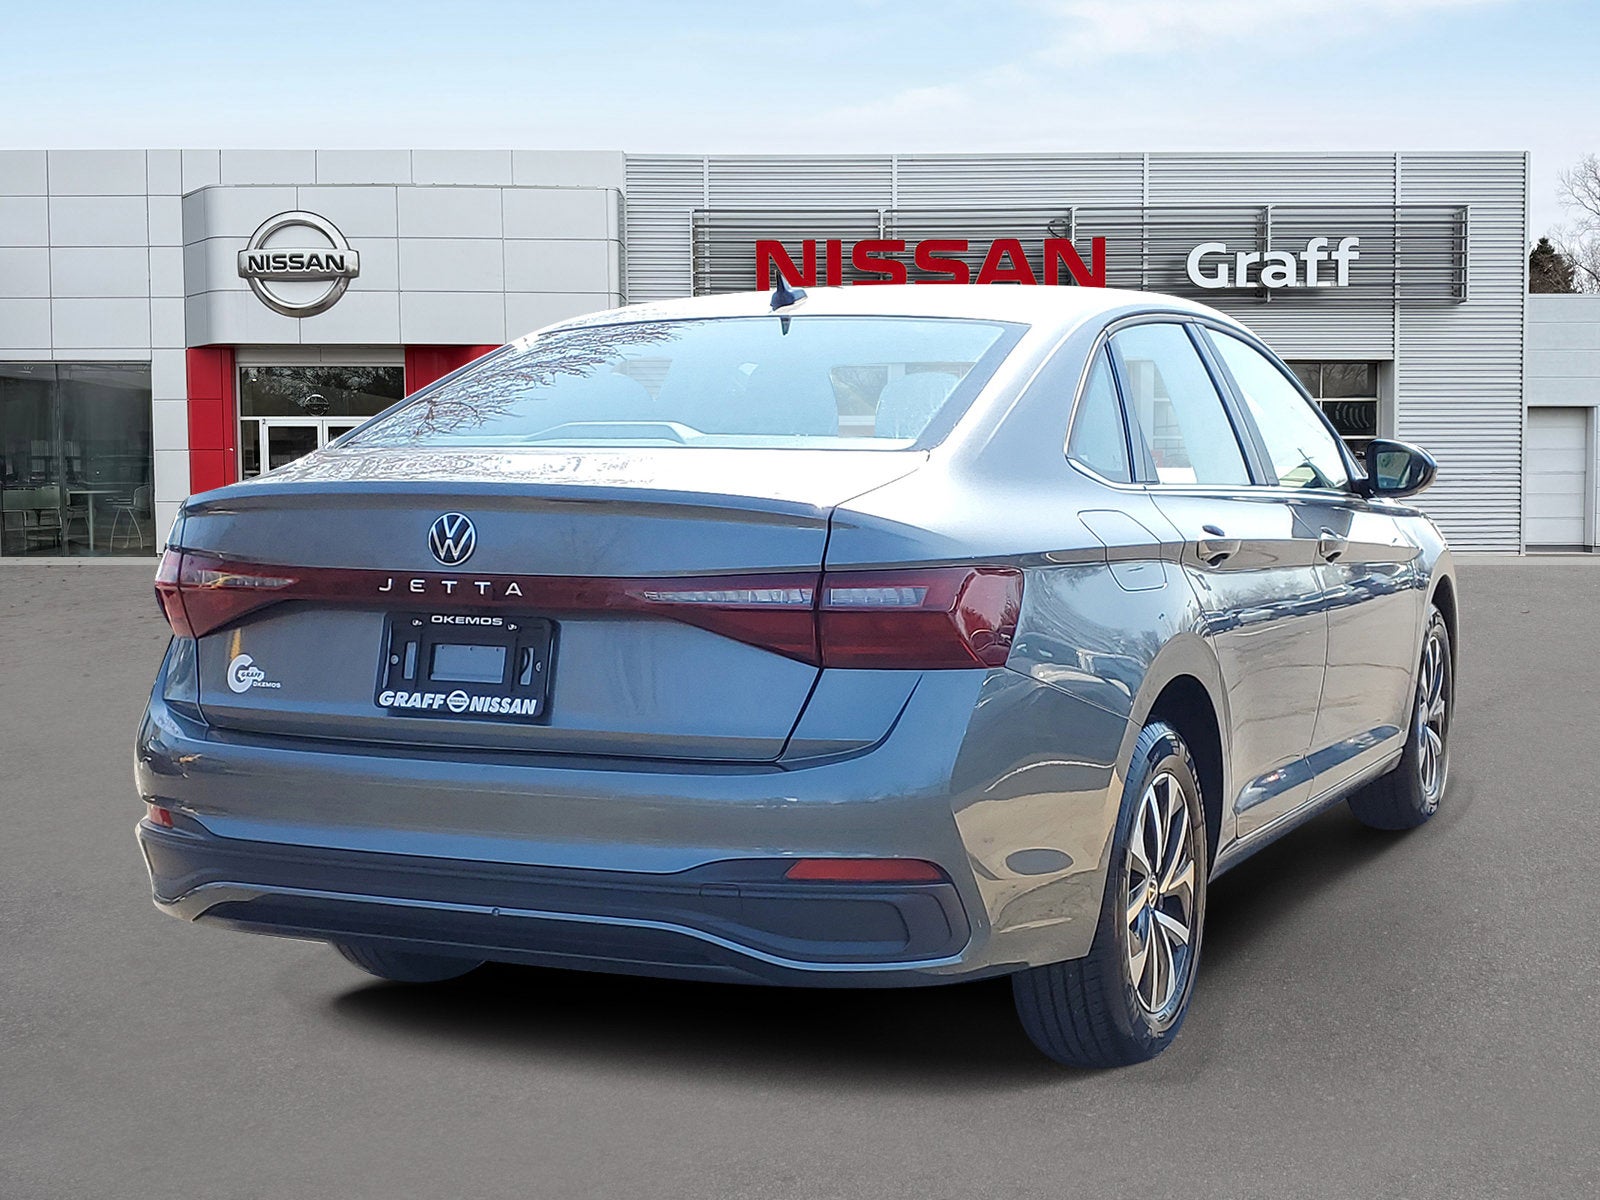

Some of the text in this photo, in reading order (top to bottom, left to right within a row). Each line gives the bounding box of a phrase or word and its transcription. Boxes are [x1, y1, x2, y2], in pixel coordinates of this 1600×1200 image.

[247, 254, 345, 271] NISSAN
[756, 237, 1106, 291] NISSAN
[1187, 237, 1360, 288] Graff
[378, 578, 523, 597] JETTA
[431, 615, 503, 626] OKEMOS
[378, 690, 537, 715] GRAFF NISSAN
